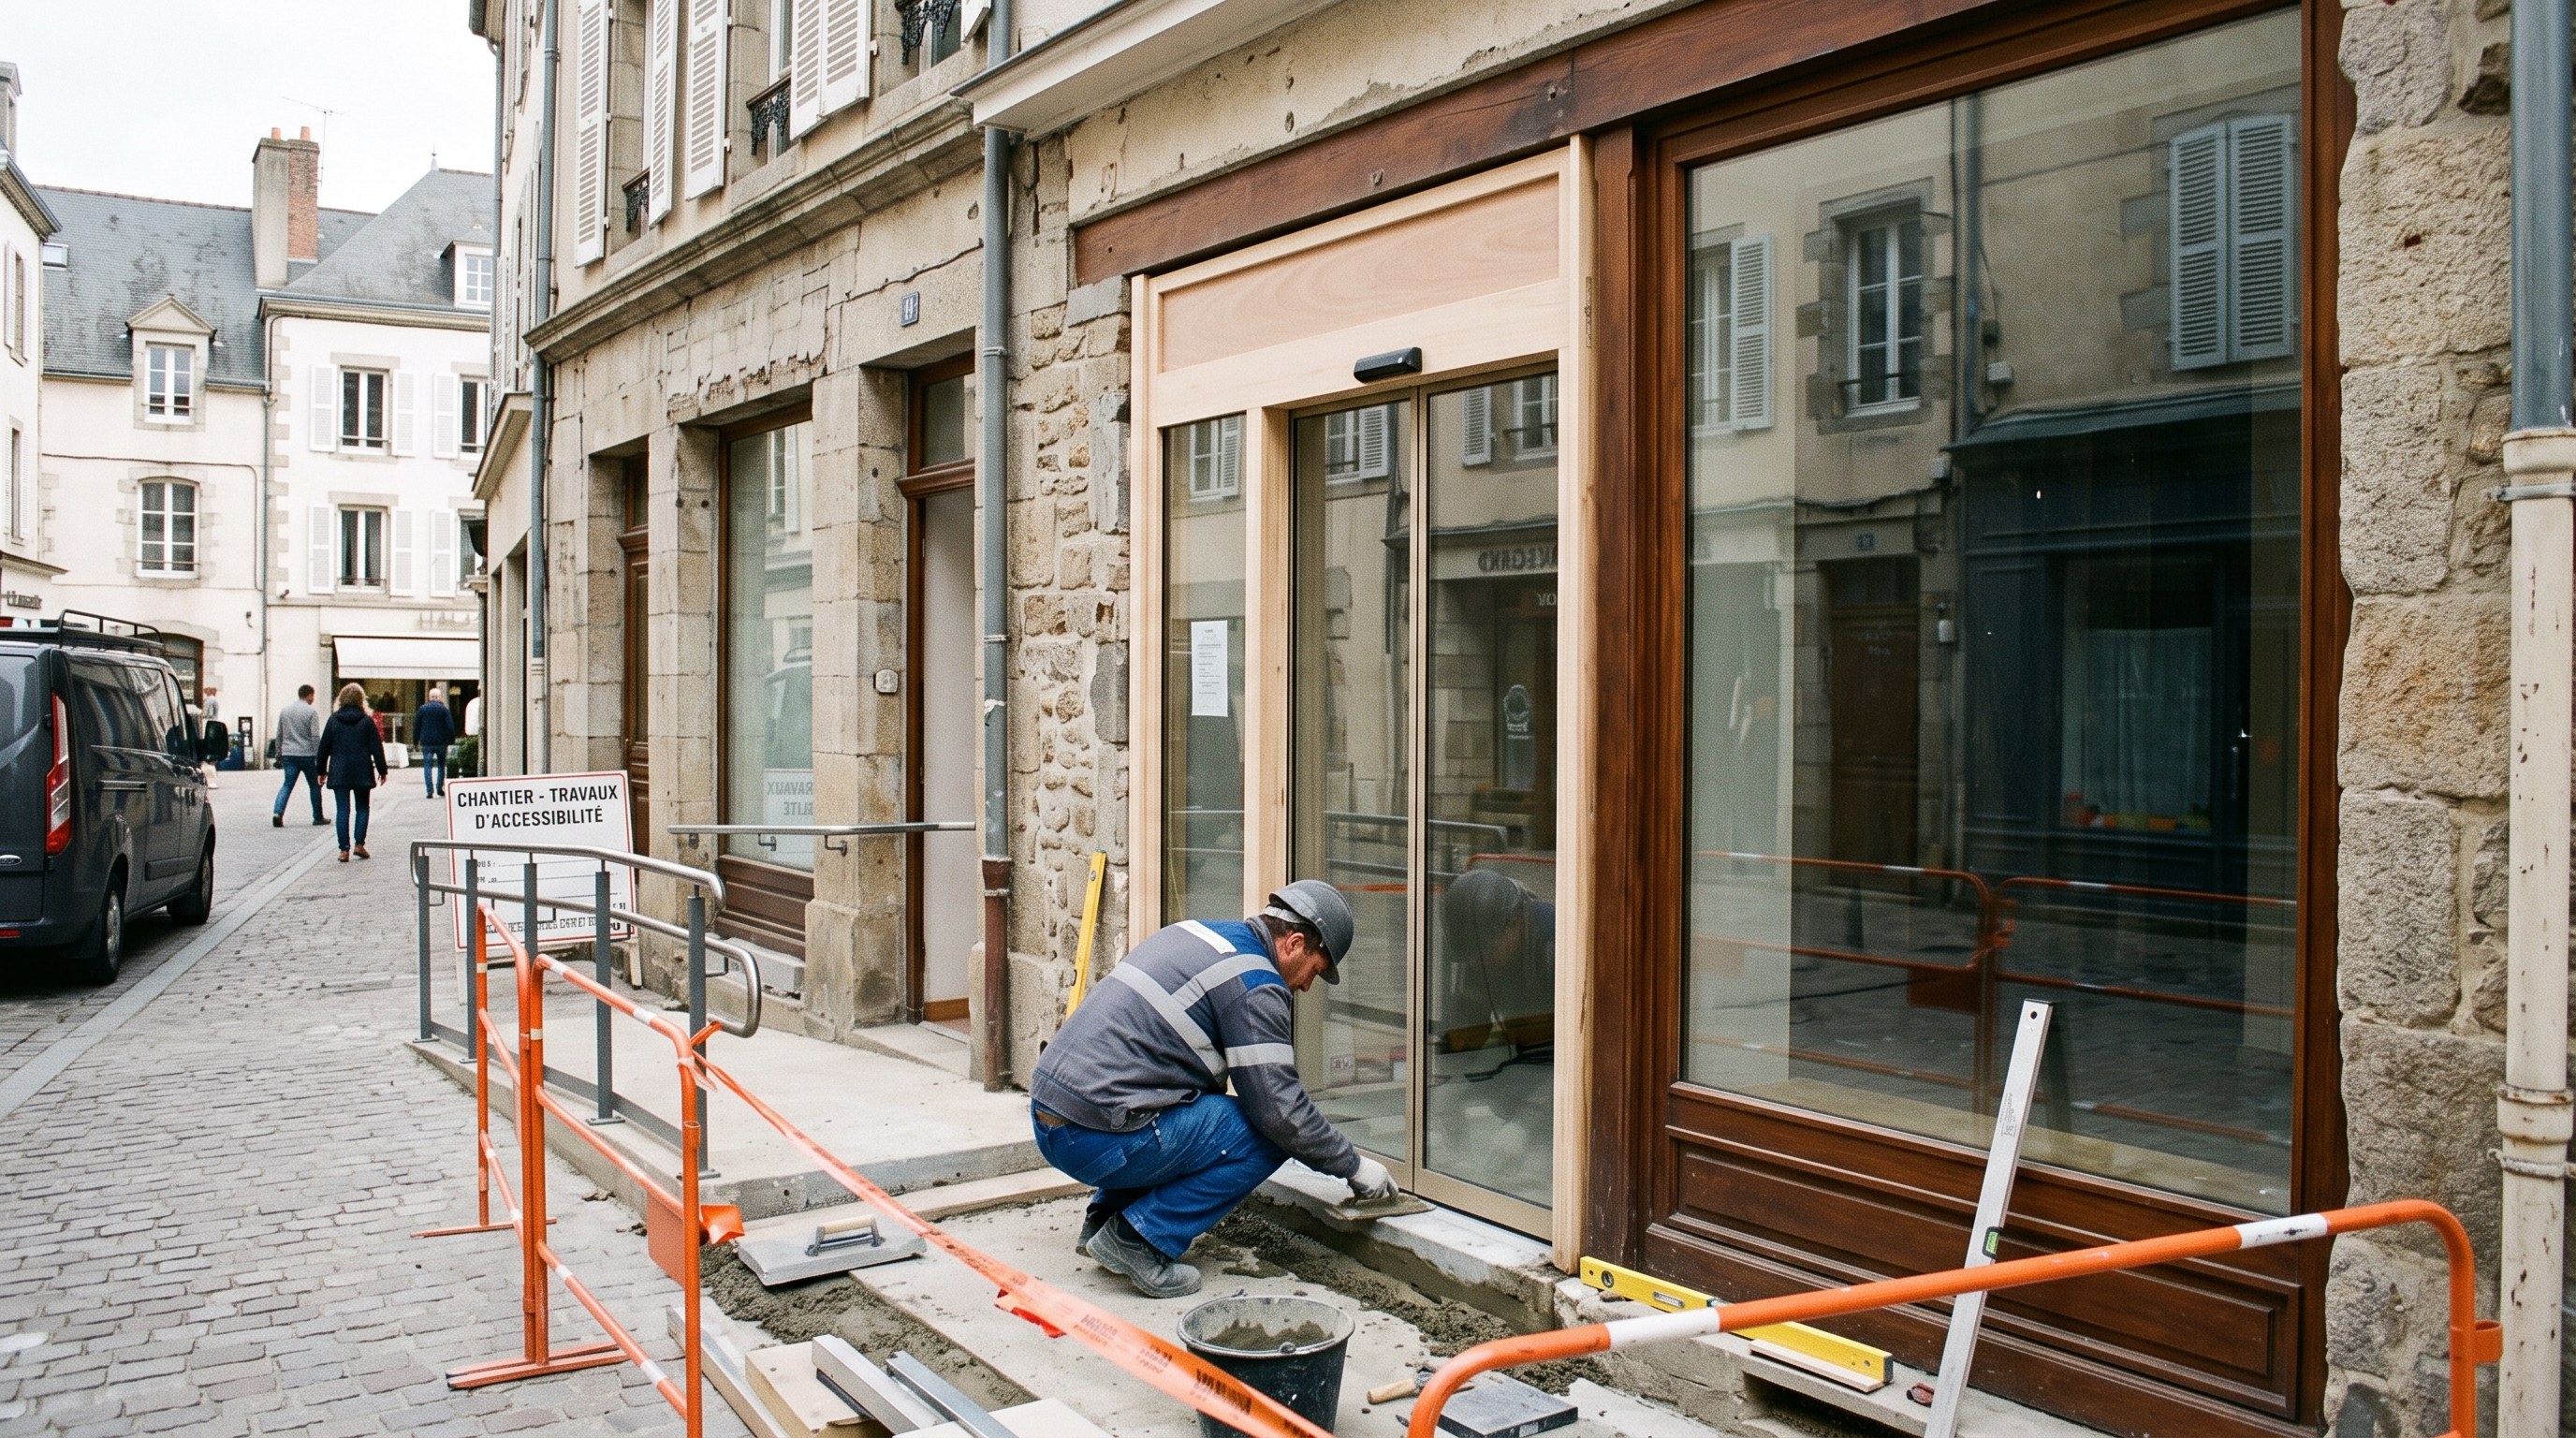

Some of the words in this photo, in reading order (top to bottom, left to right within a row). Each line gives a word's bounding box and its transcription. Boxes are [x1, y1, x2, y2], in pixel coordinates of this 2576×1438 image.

[457, 789, 534, 807] CHANTIER
[549, 785, 618, 802] TRAVAUX
[476, 805, 604, 829] D'ACCESSIBILITÉ
